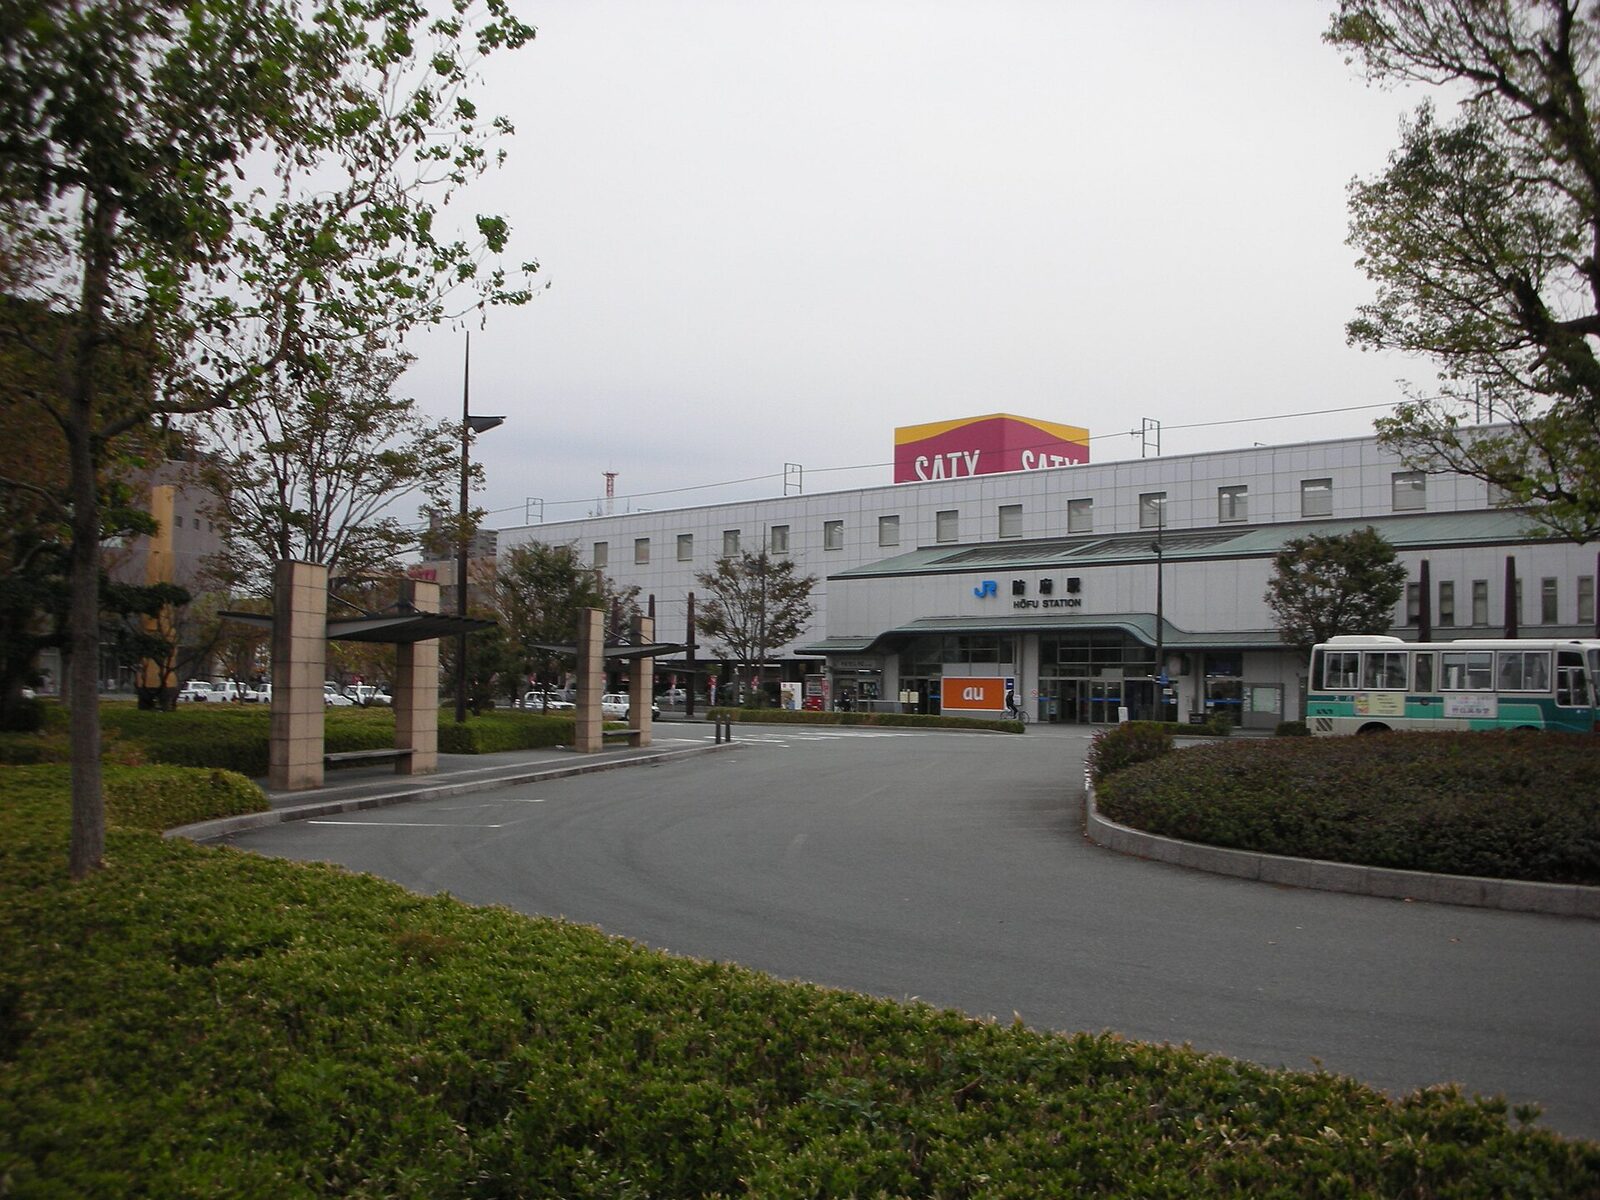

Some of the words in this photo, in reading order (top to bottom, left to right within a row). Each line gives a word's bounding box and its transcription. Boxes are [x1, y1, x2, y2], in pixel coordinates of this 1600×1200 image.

[915, 450, 980, 481] SATY
[974, 580, 997, 598] JR
[1042, 598, 1082, 608] STATION
[963, 687, 984, 700] au
